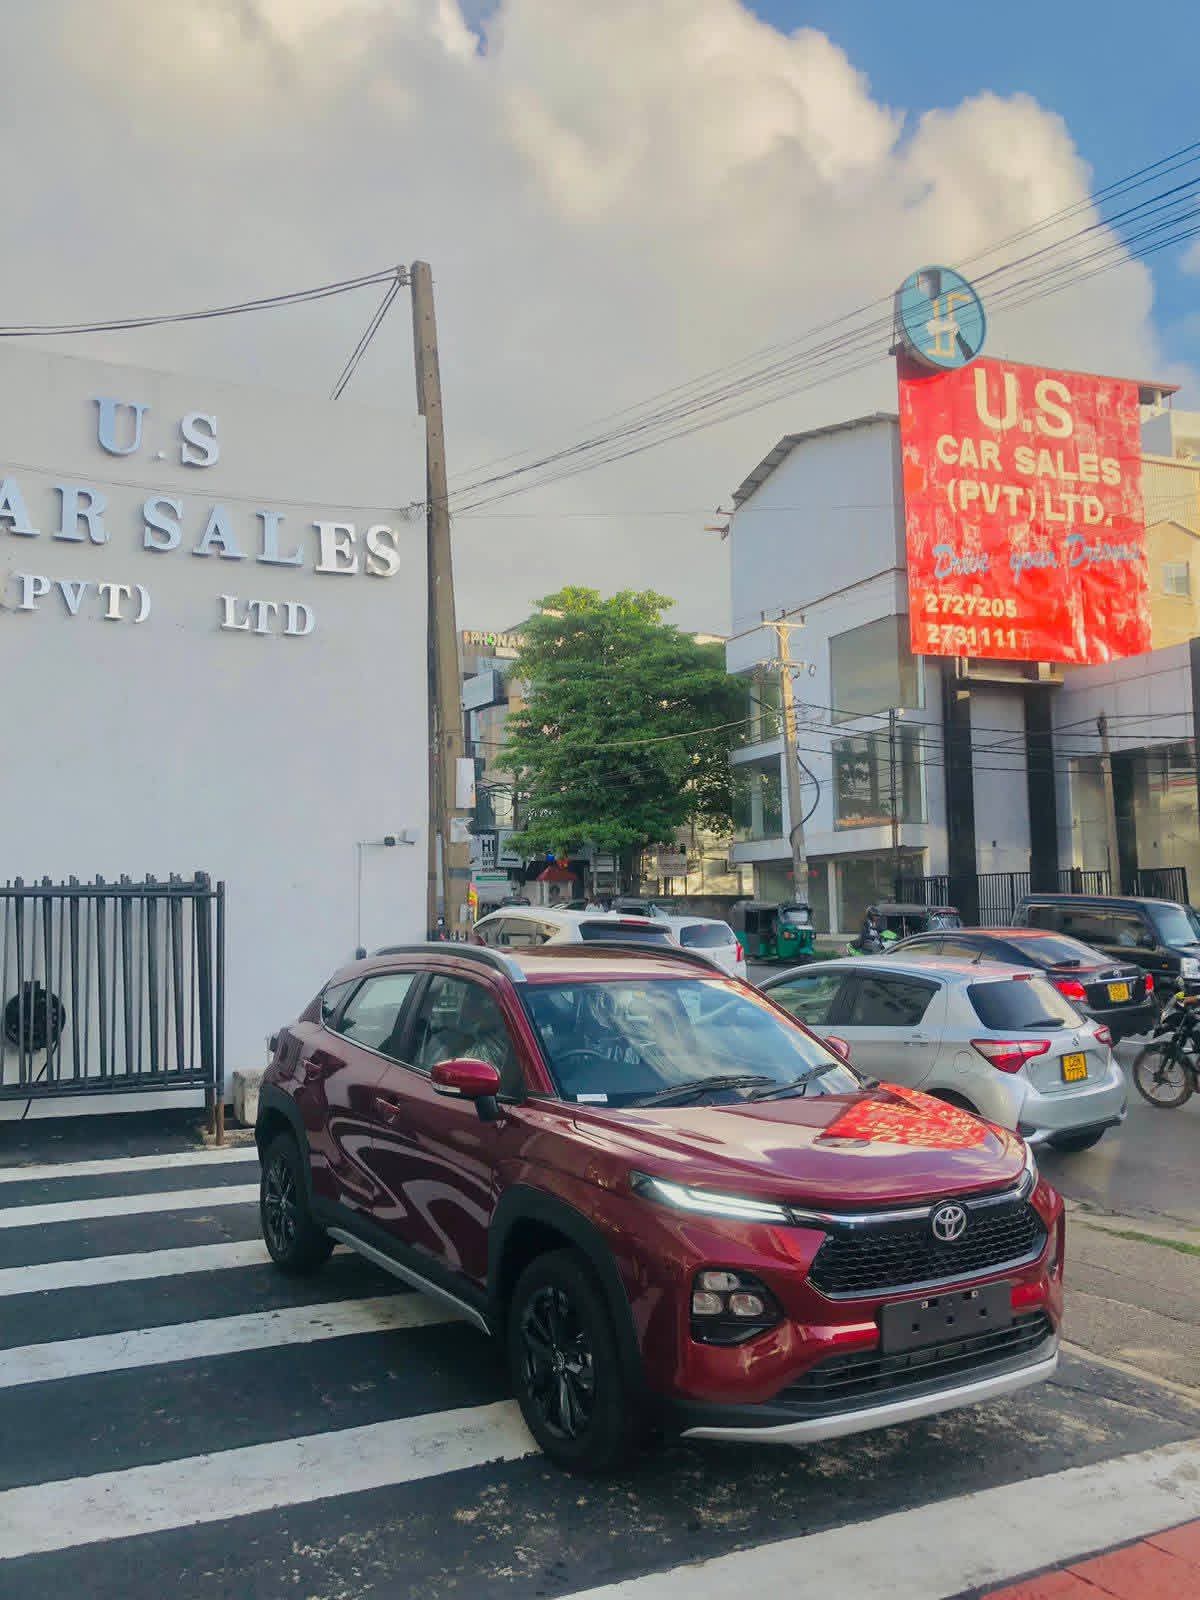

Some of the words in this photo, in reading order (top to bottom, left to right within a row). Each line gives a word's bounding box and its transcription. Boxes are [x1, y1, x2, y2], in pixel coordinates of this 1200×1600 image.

[936, 434, 1001, 471] CAR
[1015, 446, 1121, 487] SALES
[0, 475, 109, 546] AR
[141, 494, 401, 578] SALES
[12, 571, 151, 625] PVT)
[218, 592, 316, 637] LTD
[924, 592, 1018, 619] 2727205
[926, 623, 1017, 650] 2731111
